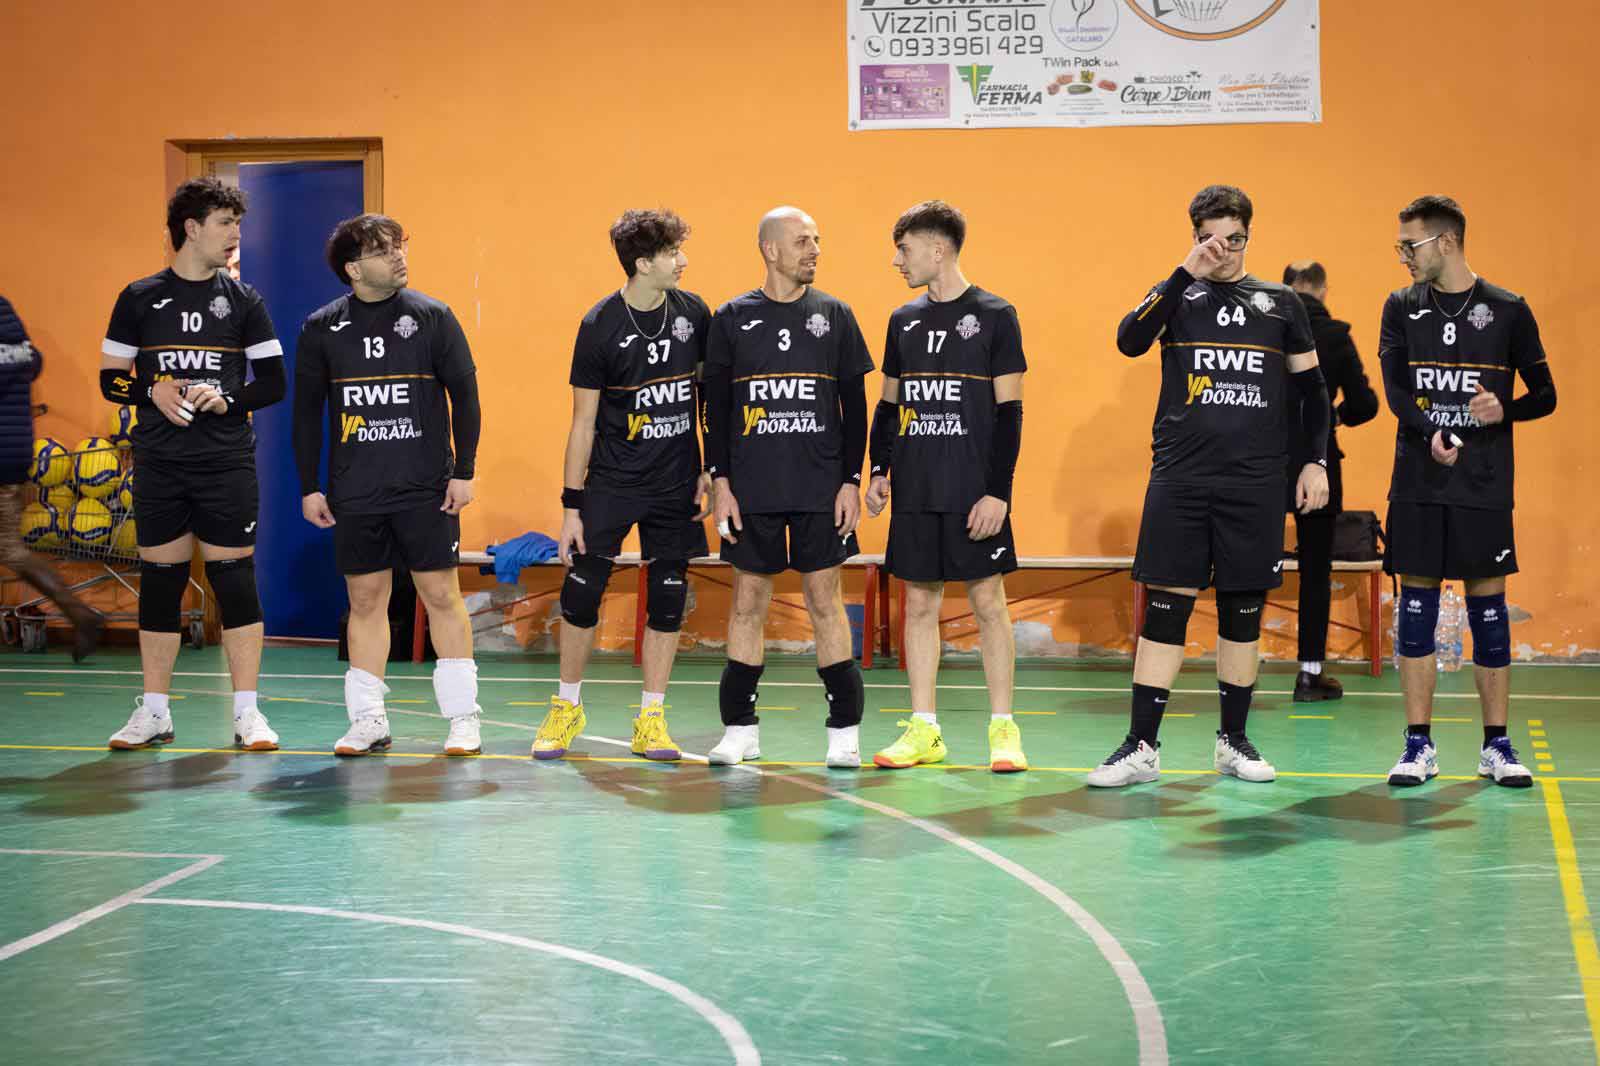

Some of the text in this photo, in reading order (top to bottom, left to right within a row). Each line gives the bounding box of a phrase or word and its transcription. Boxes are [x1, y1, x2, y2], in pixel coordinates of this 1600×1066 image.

[872, 9, 1036, 34] Vizzini Scalo
[1074, 56, 1101, 68] Pack
[976, 91, 1042, 105] FERMA
[1170, 85, 1211, 102] Diem
[181, 311, 203, 333] 10
[1216, 305, 1247, 327] 64
[778, 328, 792, 351] 3
[927, 330, 948, 353] 17
[1442, 322, 1457, 345] 8
[363, 336, 385, 359] 13
[647, 339, 671, 364] 37
[158, 350, 222, 371] RWE
[1194, 348, 1265, 374] RWE
[749, 378, 816, 401] RWE
[904, 379, 962, 401] RWE
[1416, 367, 1481, 393] RWE
[343, 383, 410, 406] RWE
[635, 379, 692, 410] RWE
[1201, 389, 1262, 408] DORATA
[358, 424, 416, 442] DORATA
[642, 418, 690, 439] DORATA
[757, 418, 818, 434] DORATA
[909, 420, 963, 436] DORATA
